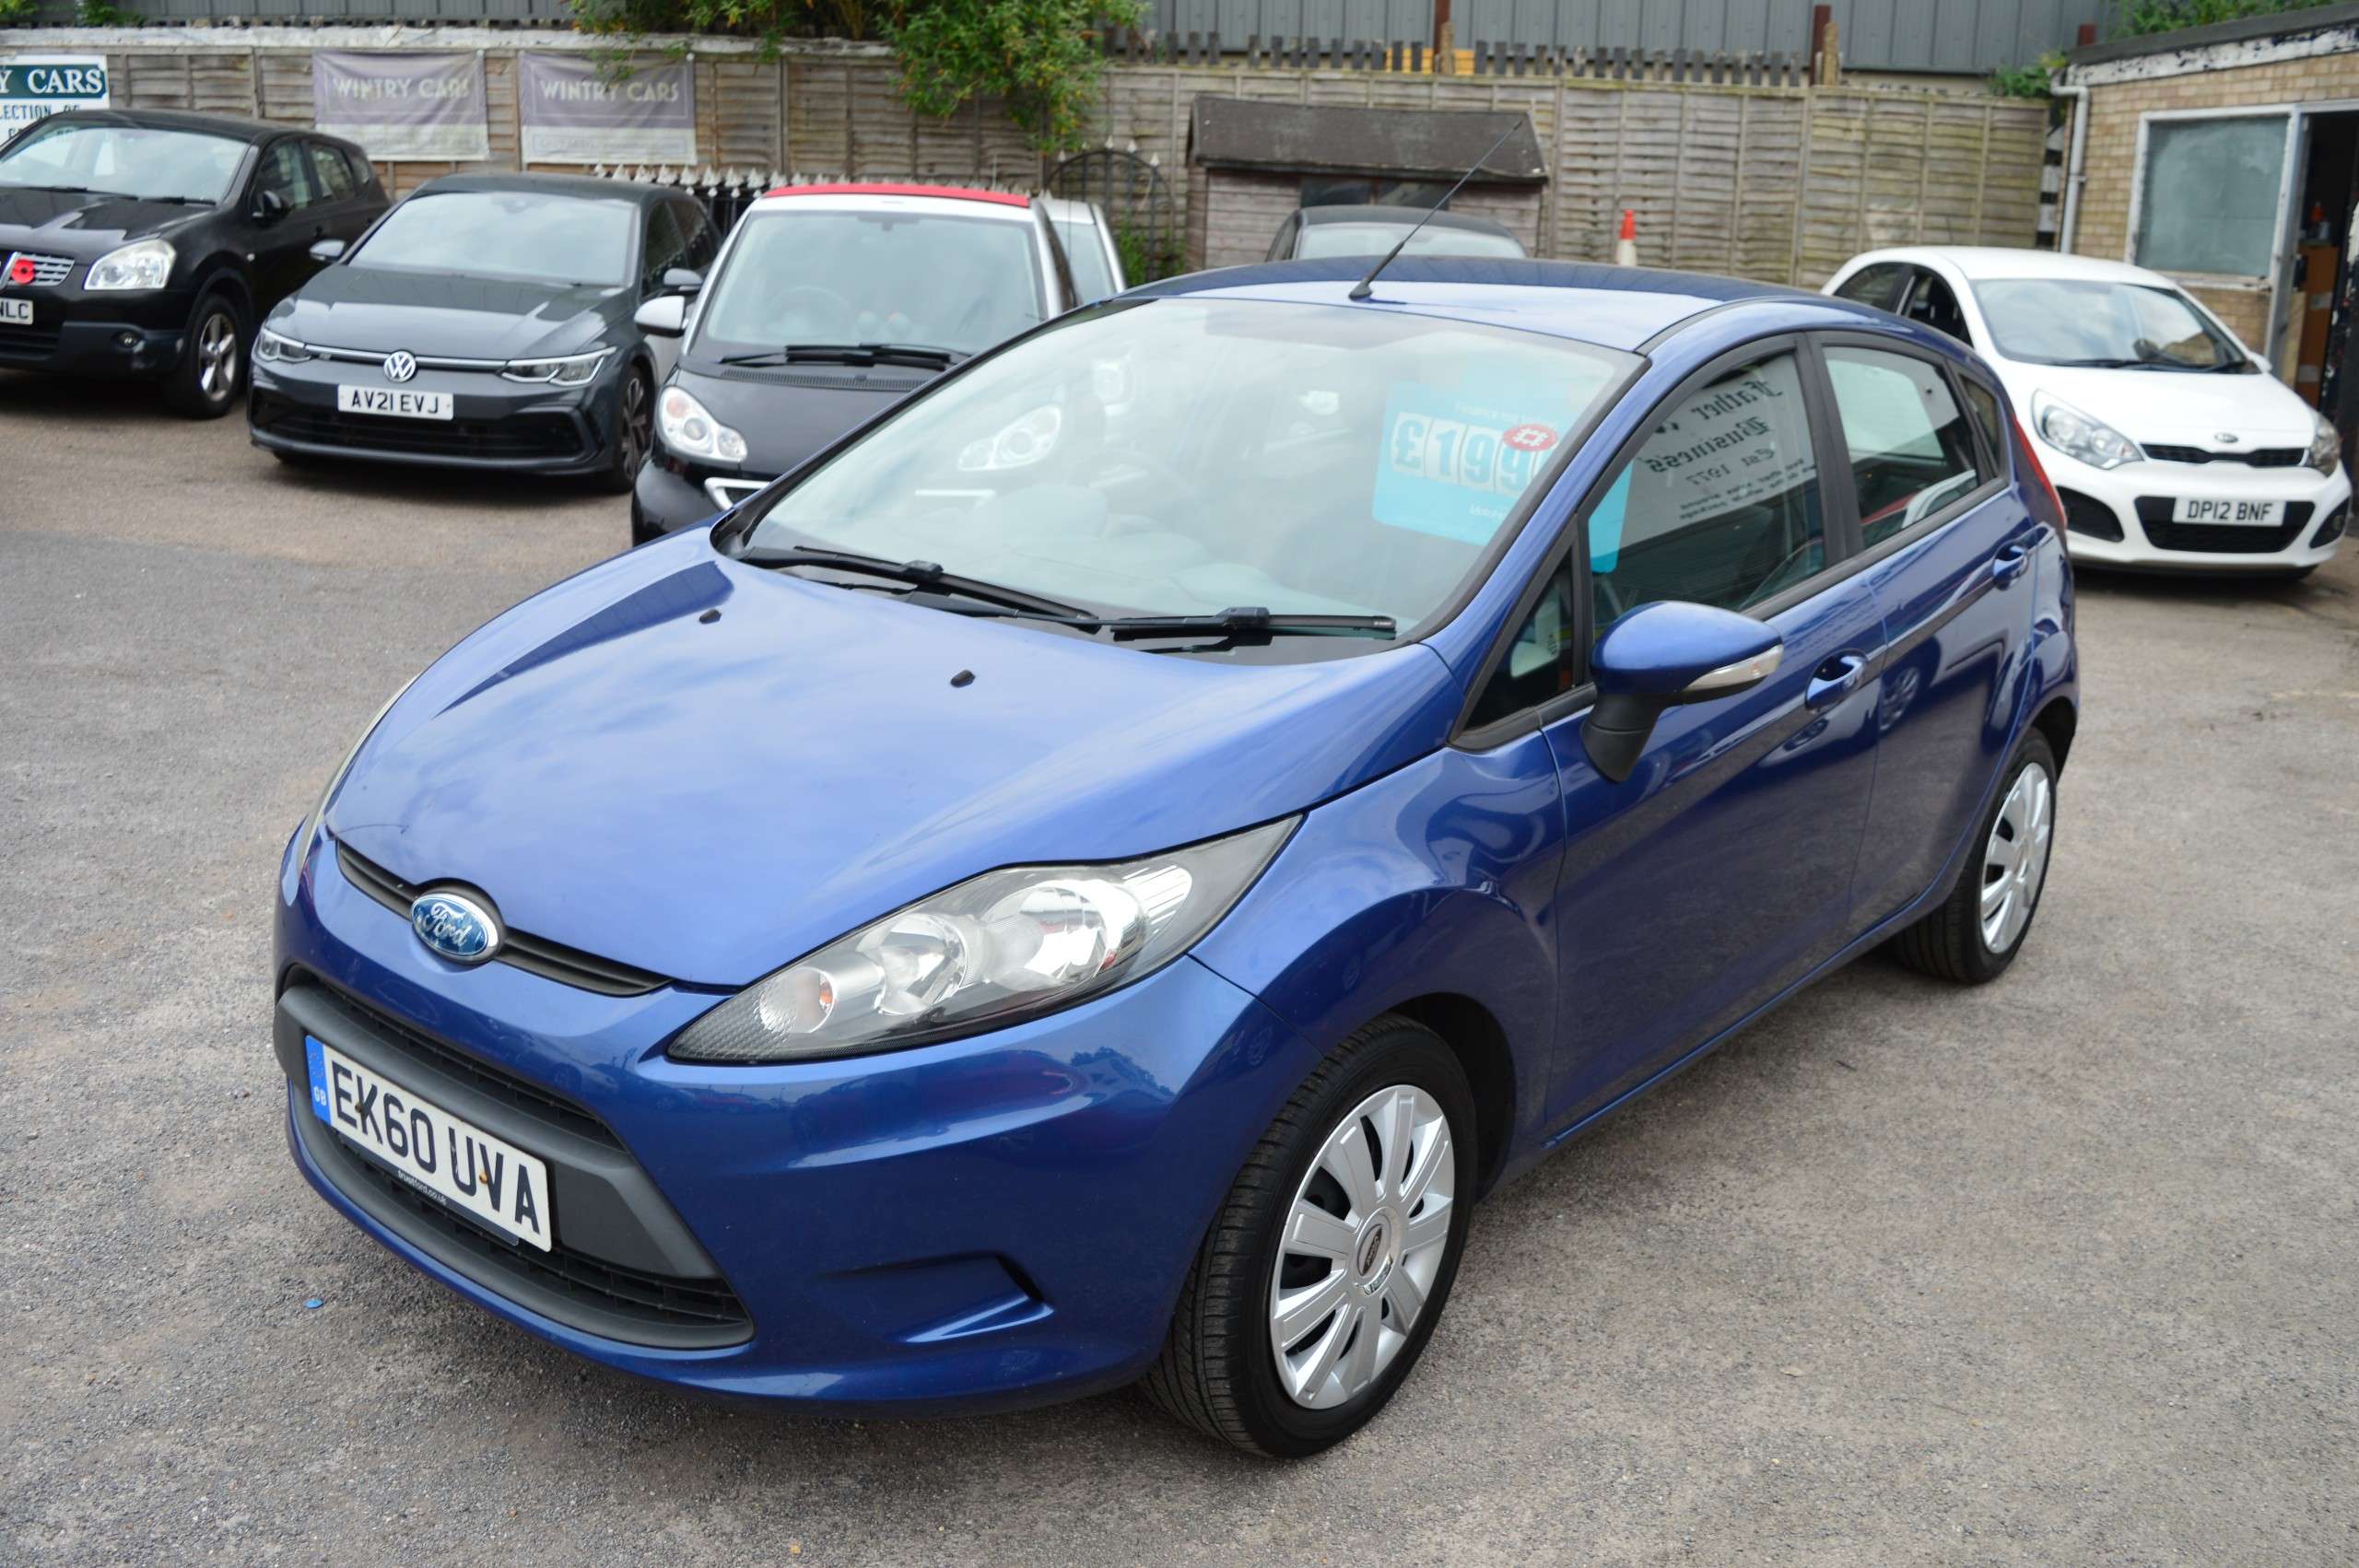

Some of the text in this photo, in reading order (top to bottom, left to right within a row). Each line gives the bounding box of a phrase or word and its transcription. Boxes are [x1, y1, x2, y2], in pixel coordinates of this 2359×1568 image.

[28, 68, 102, 93] CARS
[333, 77, 471, 99] WINTRY CARS
[540, 80, 679, 102] WINTRY CARS
[0, 104, 52, 120] ECTION
[351, 390, 439, 414] AV21 EVJ
[2187, 500, 2273, 521] DP12 BNF
[423, 901, 473, 947] Ford
[331, 1059, 541, 1235] EK60 UVA
